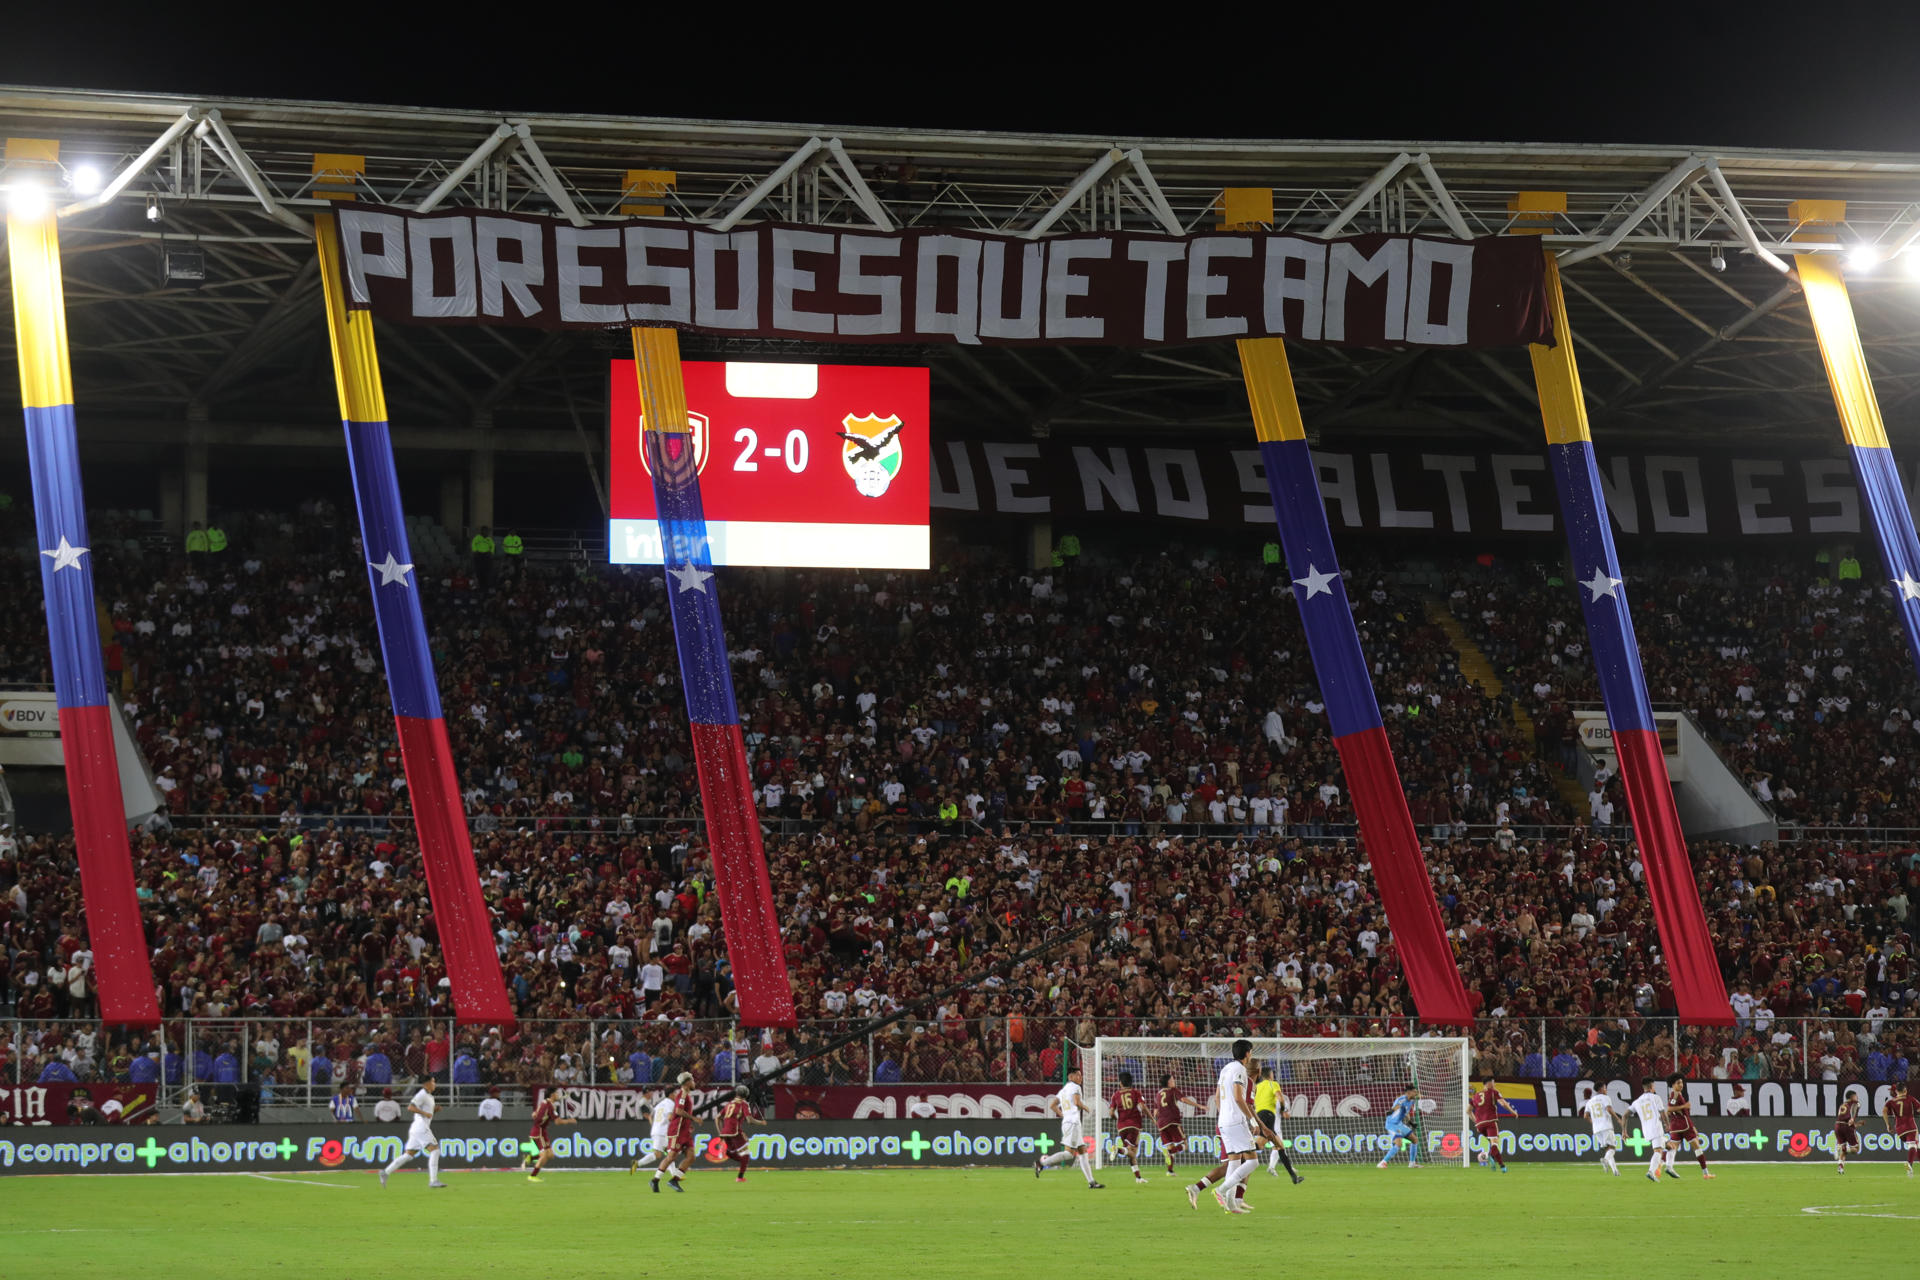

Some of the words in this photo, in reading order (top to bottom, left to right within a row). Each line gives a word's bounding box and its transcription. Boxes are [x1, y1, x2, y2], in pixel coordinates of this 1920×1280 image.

[339, 209, 544, 318] POR
[772, 228, 902, 335] ES
[915, 235, 1112, 344] QUE
[1128, 236, 1253, 340] TE
[1264, 236, 1475, 343] AMO
[1072, 446, 1209, 519] NO
[1231, 450, 1554, 532] SALTE
[1597, 456, 1708, 534] NO
[1731, 459, 1861, 534] ES
[626, 526, 714, 559] inter
[17, 710, 45, 722] BDV
[1121, 1092, 1133, 1110] 16
[1160, 1091, 1168, 1107] 2
[1478, 1092, 1486, 1106] 3
[1592, 1103, 1604, 1118] 13
[1897, 1101, 1904, 1117] 7
